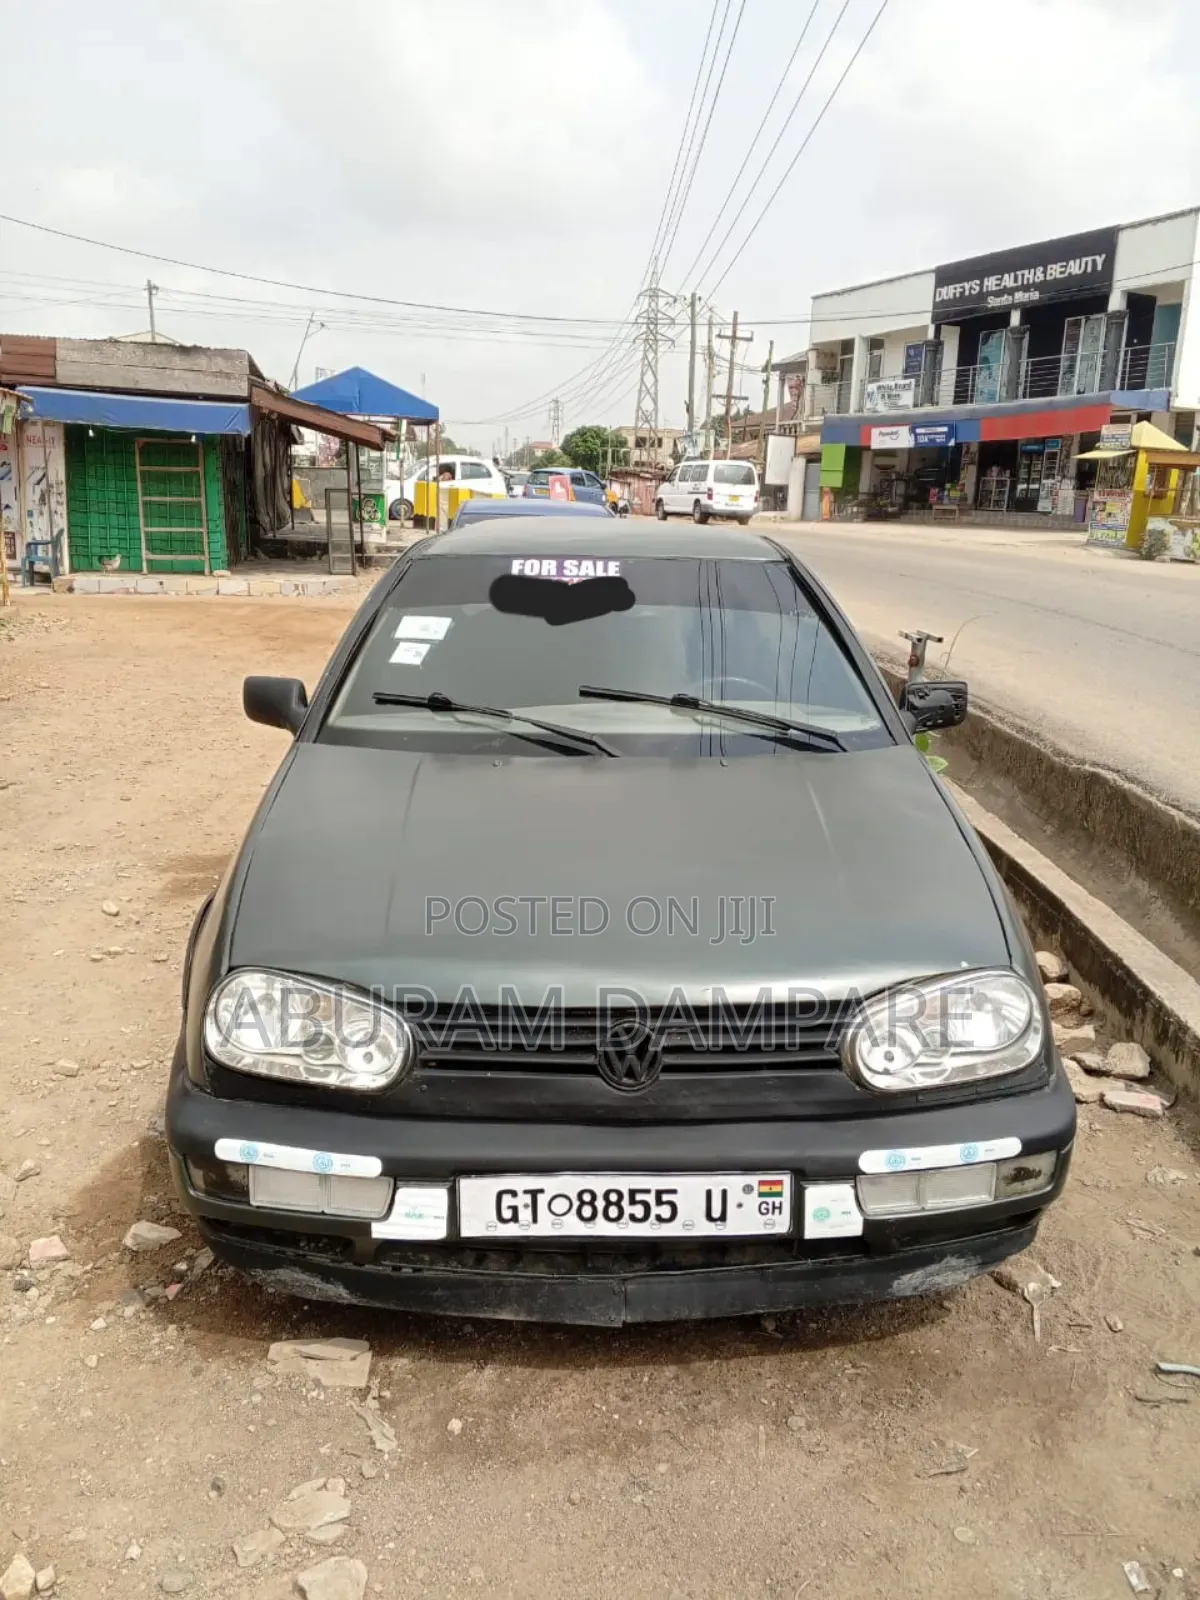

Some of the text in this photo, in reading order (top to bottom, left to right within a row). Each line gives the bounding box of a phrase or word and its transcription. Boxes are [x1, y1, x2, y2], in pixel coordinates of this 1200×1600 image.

[936, 279, 981, 303] DUFFYS
[511, 559, 621, 578] FOR SALE
[574, 1187, 679, 1224] 8855
[704, 1187, 728, 1224] U
[757, 1201, 784, 1216] GH
